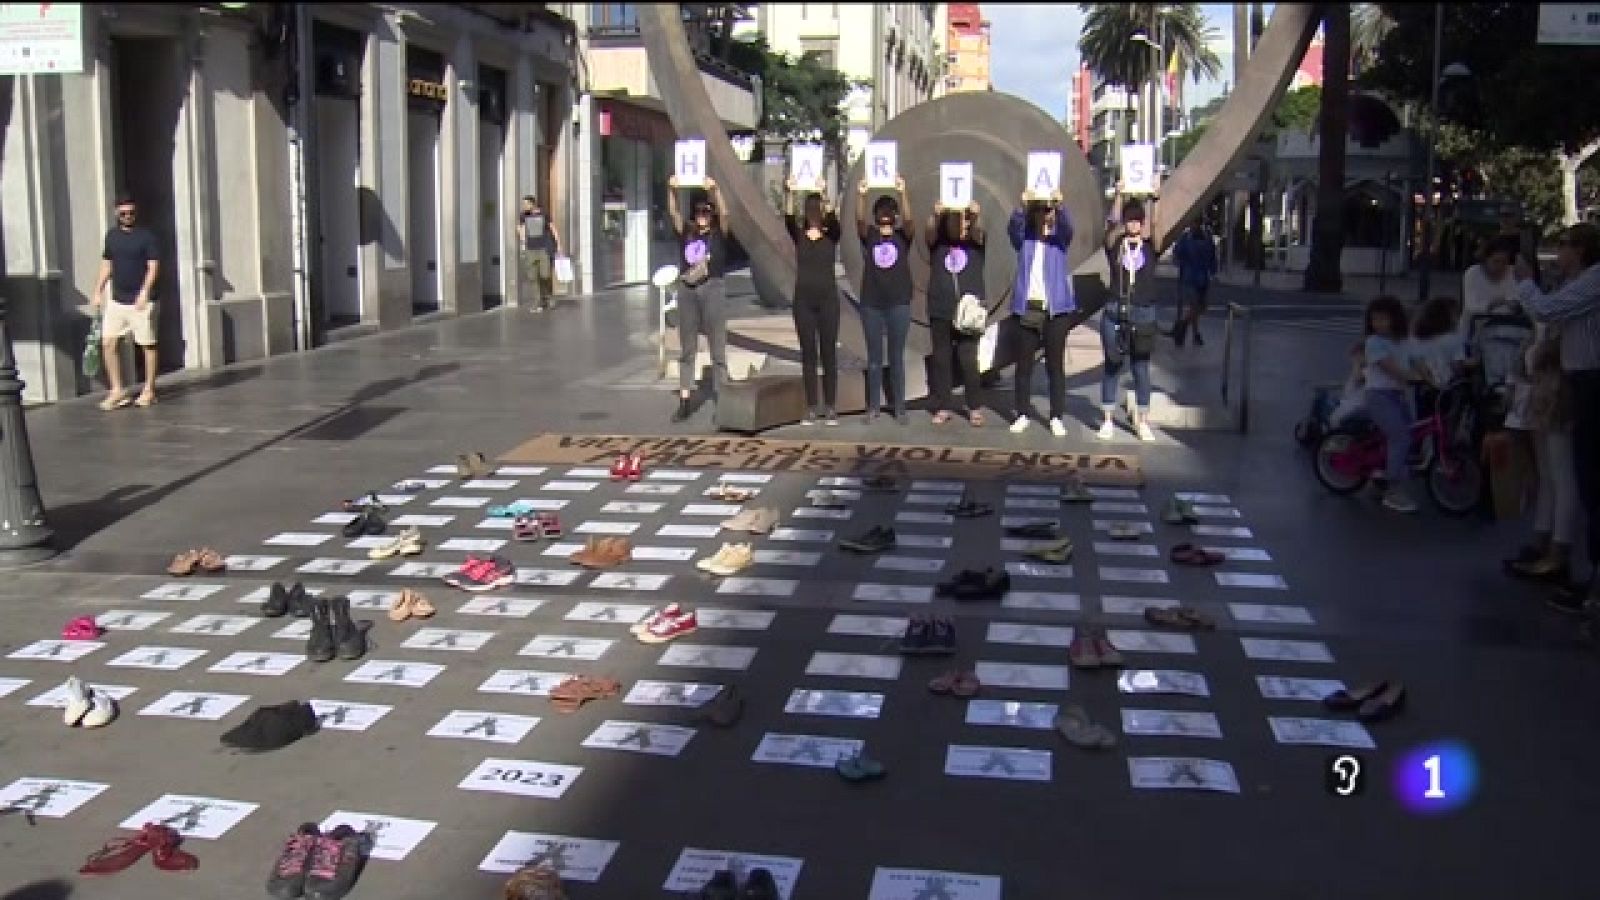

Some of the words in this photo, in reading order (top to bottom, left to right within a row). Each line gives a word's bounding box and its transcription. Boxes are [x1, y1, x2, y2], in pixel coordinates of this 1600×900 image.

[681, 152, 698, 175] H
[797, 159, 814, 179] A
[871, 155, 889, 178] R
[1129, 159, 1145, 183] S
[947, 176, 964, 198] T
[1034, 166, 1053, 189] A
[854, 444, 1129, 471] VIOLENCIA
[480, 767, 565, 788] 2023
